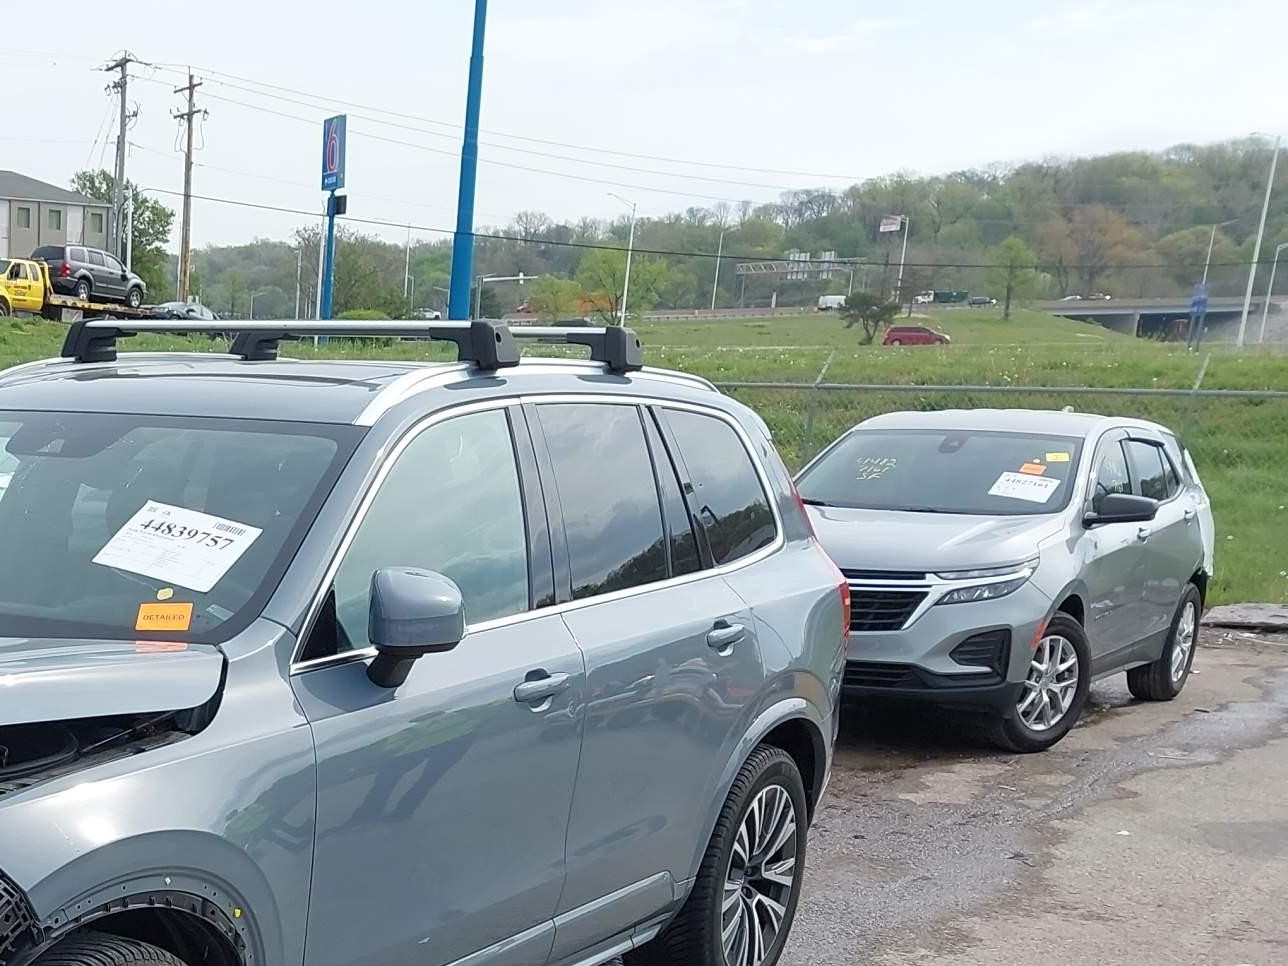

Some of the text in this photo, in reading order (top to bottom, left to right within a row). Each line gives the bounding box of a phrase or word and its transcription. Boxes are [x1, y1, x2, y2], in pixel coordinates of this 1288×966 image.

[327, 118, 339, 173] 6
[139, 519, 235, 550] 44839757
[142, 613, 185, 622] DETAILED
